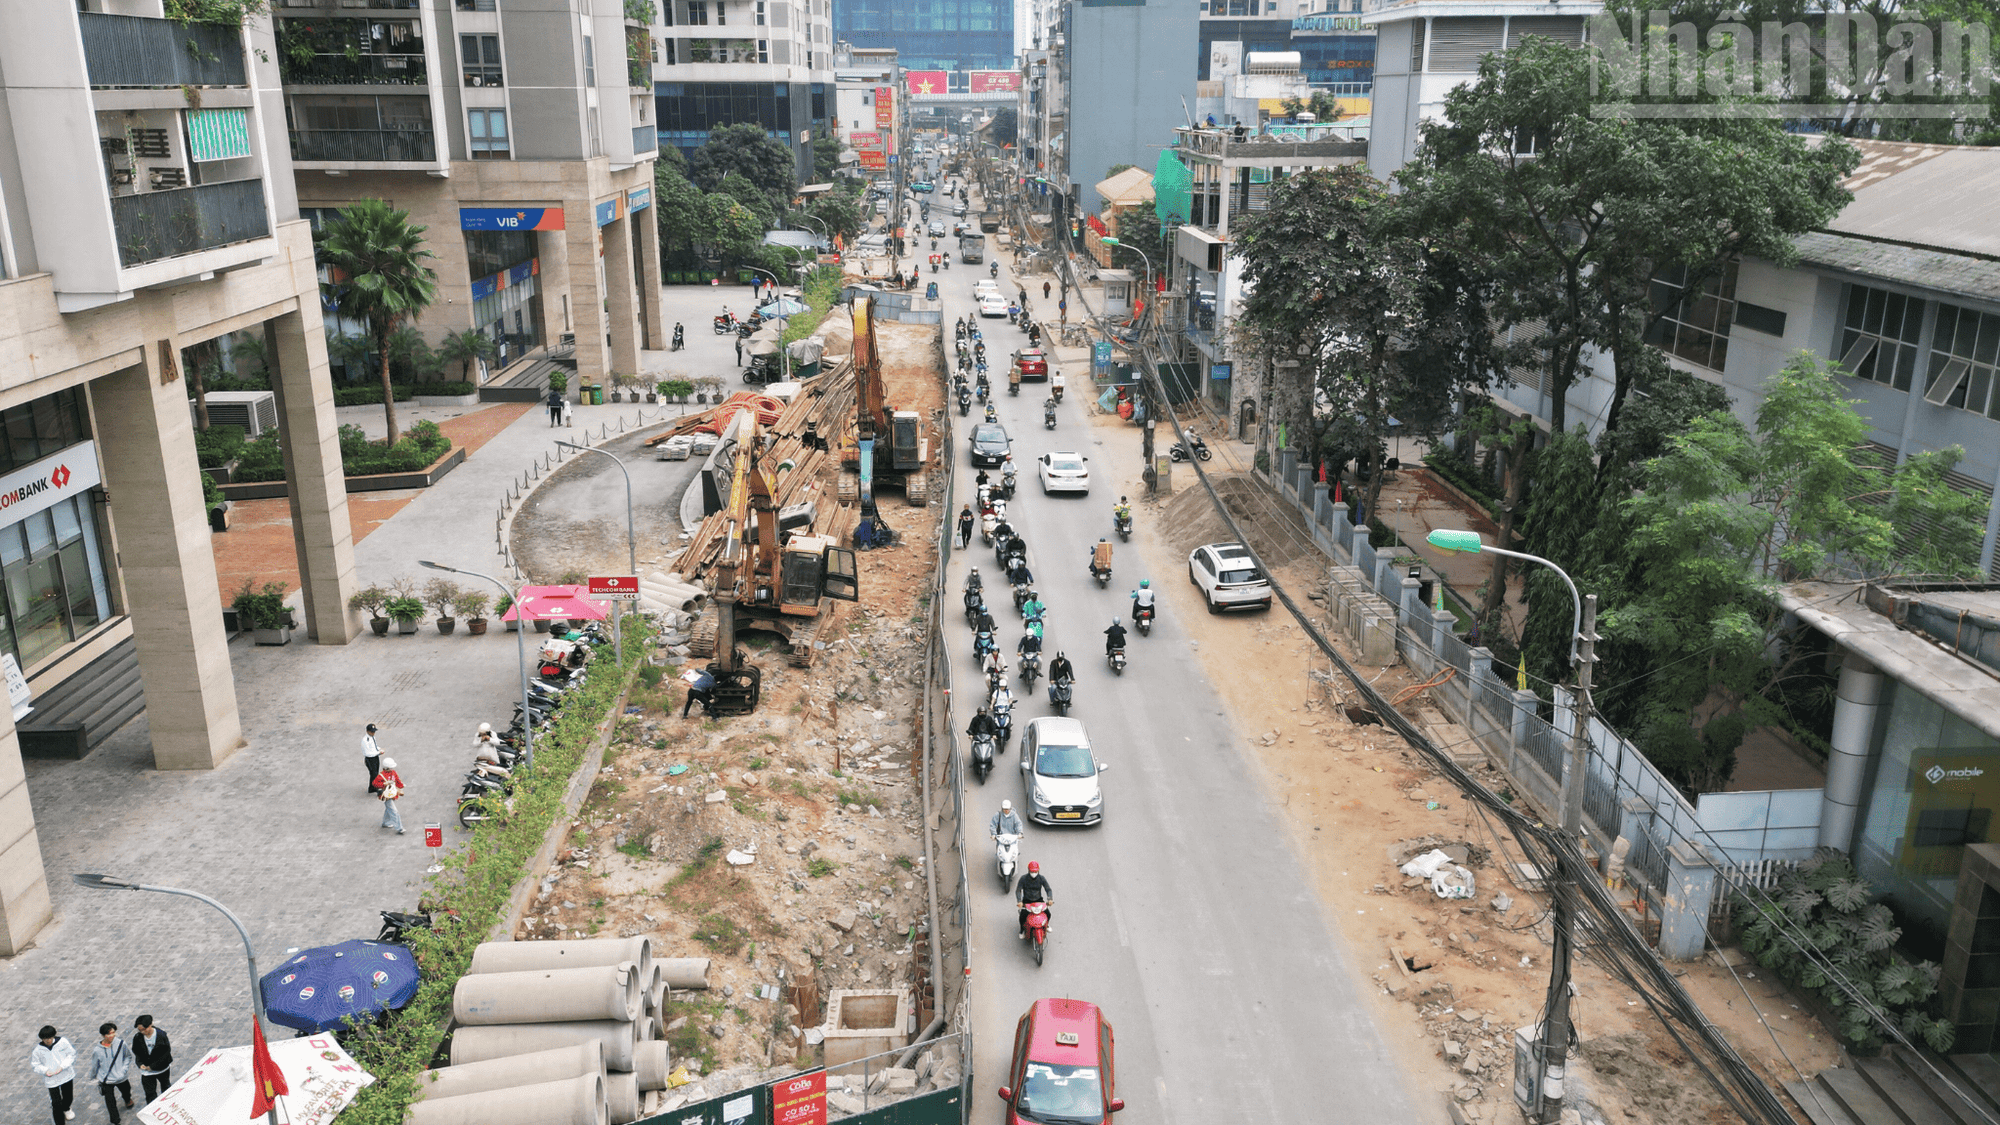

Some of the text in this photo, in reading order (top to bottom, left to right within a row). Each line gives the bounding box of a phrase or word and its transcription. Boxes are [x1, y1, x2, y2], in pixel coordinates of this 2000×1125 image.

[496, 217, 519, 227] VIB
[0, 477, 49, 511] OMBANK
[1946, 766, 1984, 777] mobile
[426, 831, 433, 839] P
[1059, 1034, 1077, 1042] TAXI
